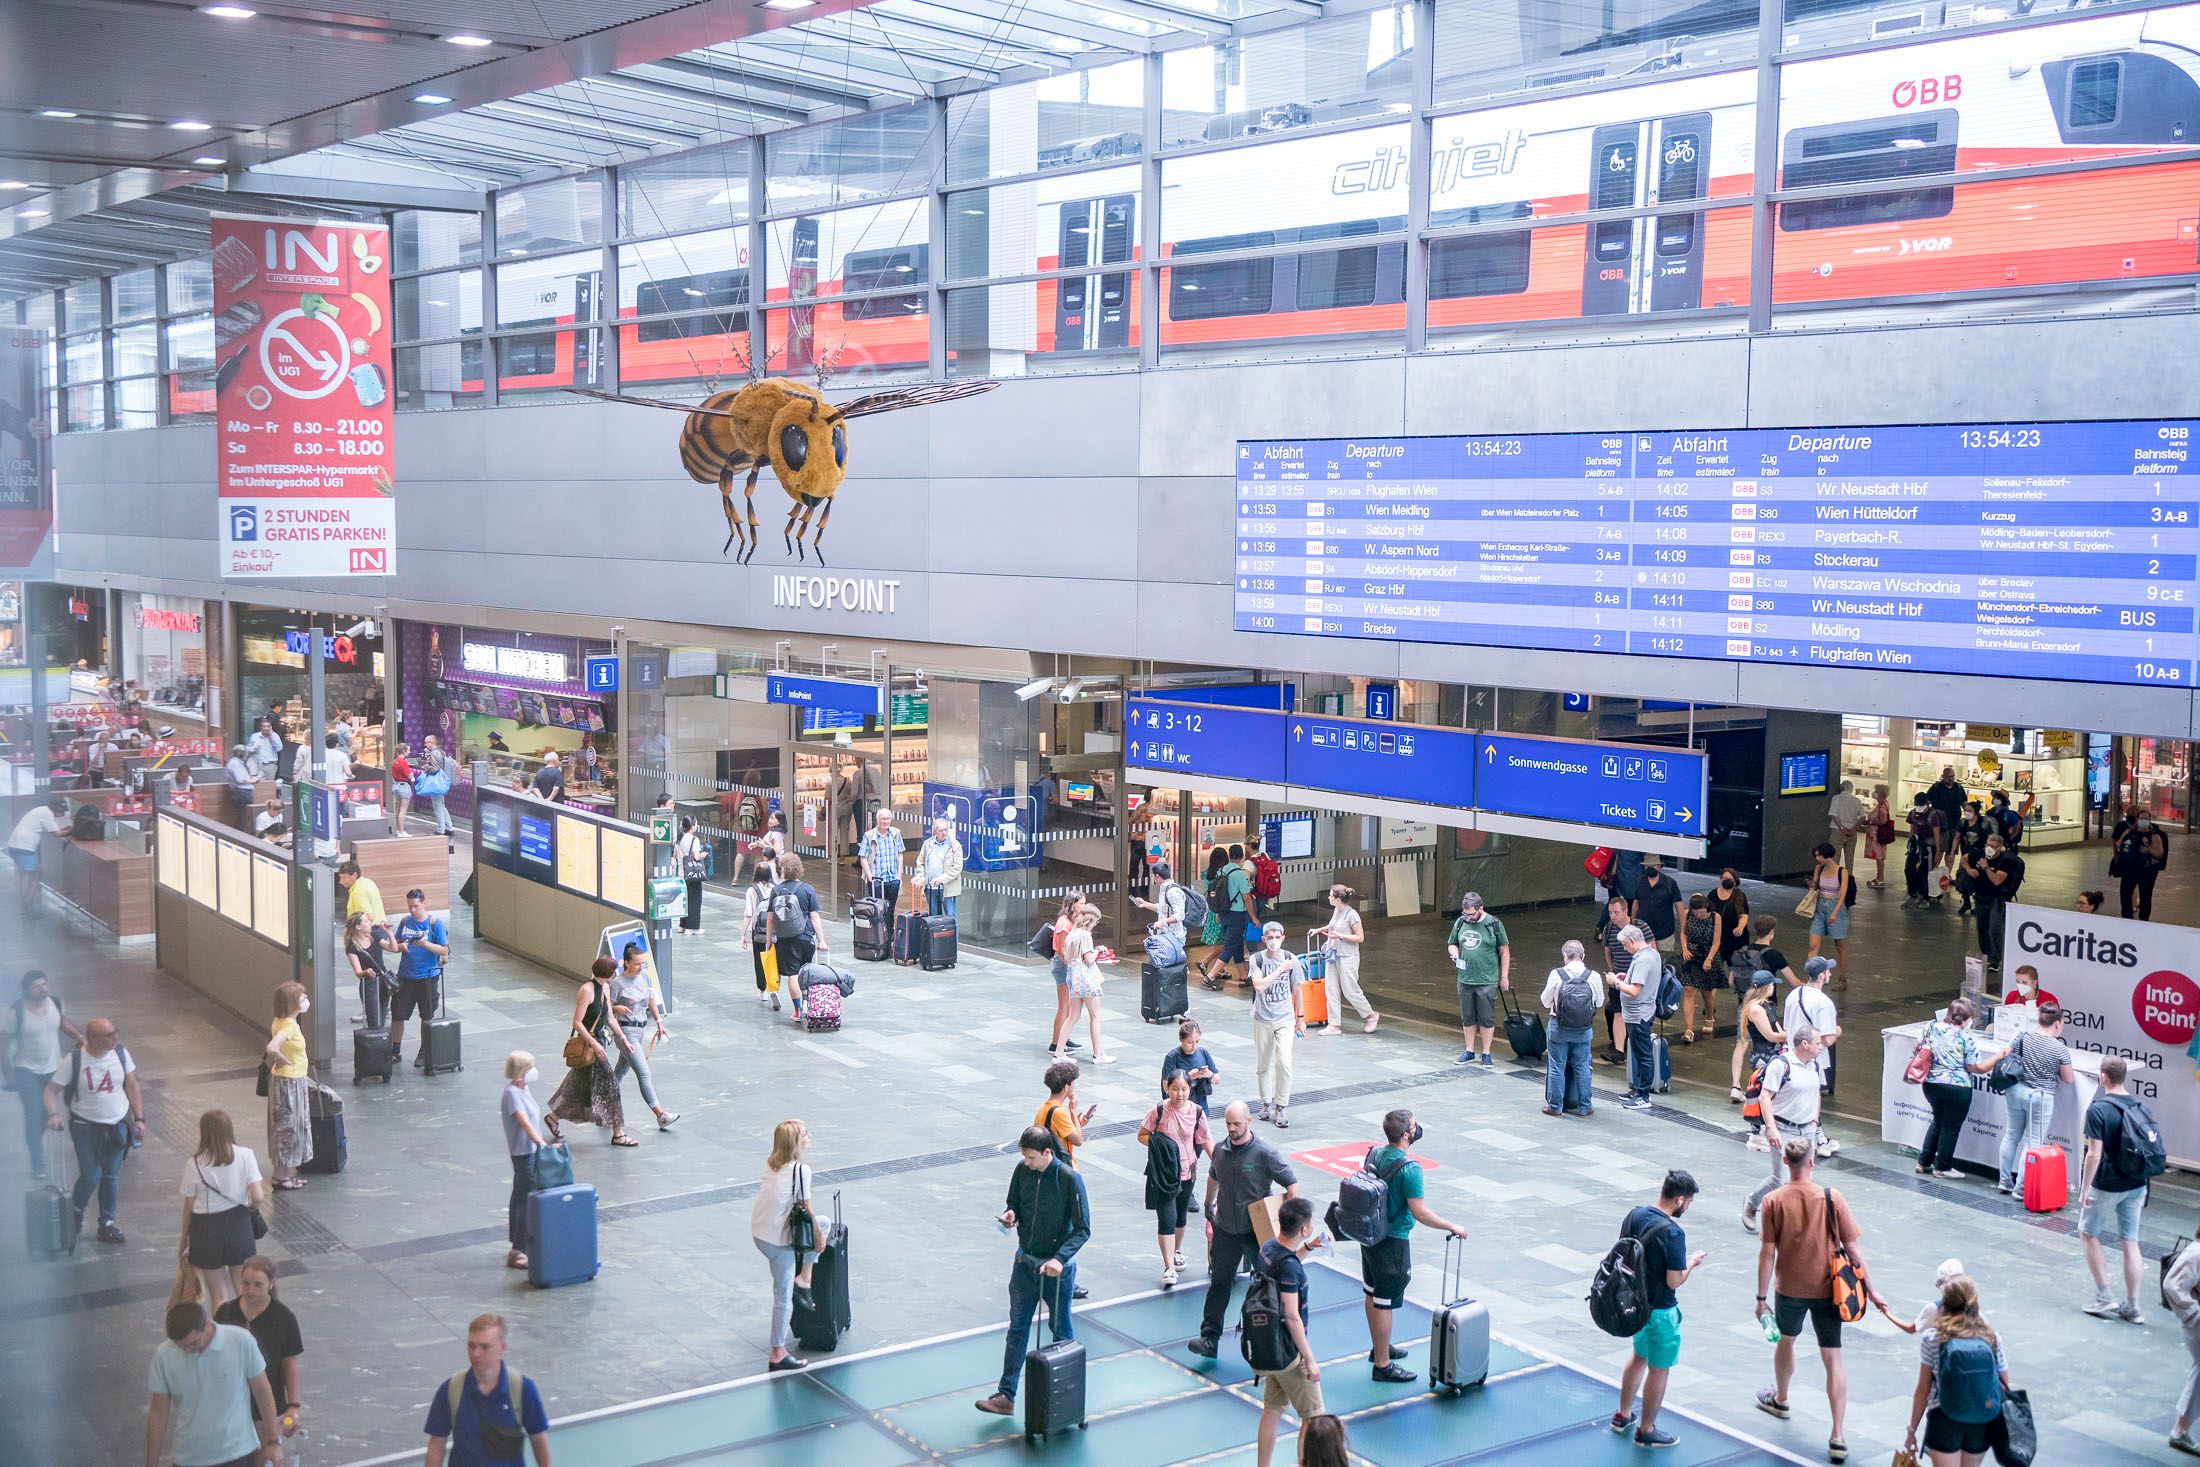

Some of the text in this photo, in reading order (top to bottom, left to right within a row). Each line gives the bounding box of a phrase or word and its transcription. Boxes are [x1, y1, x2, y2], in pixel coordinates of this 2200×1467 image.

[1892, 74, 1962, 108] ÖBB
[265, 229, 339, 273] IN
[1912, 237, 1952, 252] VOR
[1600, 269, 1623, 280] ÖBB
[279, 353, 292, 362] im
[279, 366, 300, 375] UG1
[228, 421, 250, 432] Mo
[266, 422, 279, 432] Fr
[294, 422, 322, 434] 8.30
[337, 420, 383, 435] 21.00
[2158, 428, 2188, 439] ÖBB
[228, 442, 246, 453] Sa
[294, 443, 322, 454] 8.30
[337, 440, 384, 455] 18.00
[1672, 430, 2040, 452] Abfahrt Departure 13:54:23
[1264, 441, 1521, 459] Abfahrt Departure 13:54:23
[1696, 455, 1728, 464] Erwartet
[1761, 454, 1777, 465] Zug
[1818, 454, 1839, 462] nach
[2135, 449, 2186, 461] Bahnsteig
[1586, 457, 1621, 466] Bahnsteig
[229, 464, 379, 476] Zum INTERSPAR-Hypermarkt
[1585, 469, 1615, 478] platform
[1696, 468, 1735, 476] estimated
[1761, 468, 1779, 476] train
[1818, 467, 1826, 475] to
[2133, 463, 2178, 475] platform
[245, 477, 320, 489] Untergeschoß
[324, 478, 343, 487] UG1
[1657, 484, 1688, 496] 14:02
[1760, 486, 1773, 495] S3
[1903, 482, 1928, 495] Hbf
[2154, 482, 2160, 495] 1
[264, 510, 350, 522] 2 STUNDEN
[1254, 504, 1276, 514] 13:53
[1366, 505, 1389, 515] Wien
[1392, 505, 1429, 517] Meidling
[1599, 506, 1603, 516] 1
[1656, 505, 2187, 522] 14:05 S80 Wien Hütteldorf Kurzzug 3 A-B
[236, 517, 254, 538] P
[266, 528, 386, 541] GRATIS PARKEN!
[1656, 528, 1902, 546] 14:08 REX3 Payerbach-R.
[232, 550, 247, 558] Ab
[251, 550, 260, 558] €
[1253, 542, 1275, 552] 13:56
[1365, 544, 1378, 554] W.
[1381, 544, 1413, 557] Aspern
[1417, 545, 1438, 555] Nord
[1596, 549, 1603, 560] 3
[1606, 552, 1620, 560] A-B
[233, 562, 272, 571] Einkauf
[352, 551, 383, 569] IN
[1655, 550, 2159, 574] 14:09 R3 Stockerau 2
[774, 575, 900, 613] INFOPOINT
[1252, 580, 1619, 603] 13:58 Graz Hbf 8 A-B
[1654, 572, 1685, 584] 14:10
[1757, 578, 1771, 587] EC
[1813, 576, 1880, 591] Warszawa
[1885, 578, 1960, 593] Wschodnia
[1979, 578, 1998, 586] über
[2000, 579, 2034, 587] Breclav
[2147, 586, 2157, 600] 9
[2160, 590, 2184, 601] C-E
[1978, 590, 2034, 600] über Ostrava
[1653, 594, 1683, 606] 14:11
[1756, 601, 1774, 610] S60
[1899, 603, 1923, 617] Hbf
[2120, 611, 2155, 626] BUS
[1252, 617, 1601, 647] 14:00 Breclav 2
[1652, 616, 2152, 651] 14:11 S2 Mödling 1
[1976, 639, 2080, 651] Brunn-Maria Enzersdorf
[1652, 638, 2179, 680] 14:12 RJ Flughafen Wien 10 A-B
[789, 691, 812, 701] InfoPoint
[1166, 713, 1173, 729] 3
[1186, 715, 1201, 732] 12
[1331, 733, 1336, 742] R
[1364, 735, 1369, 745] P
[1177, 754, 1190, 764] WC
[1509, 756, 1588, 774] Sonnwendgasse
[1600, 804, 1636, 818] Tickets
[2018, 921, 2138, 968] Caritas
[2146, 984, 2183, 1006] Info
[2144, 1006, 2195, 1029] Point
[84, 1066, 114, 1094] 14
[2132, 1080, 2157, 1098] та
[1973, 1127, 1997, 1138] Каритас
